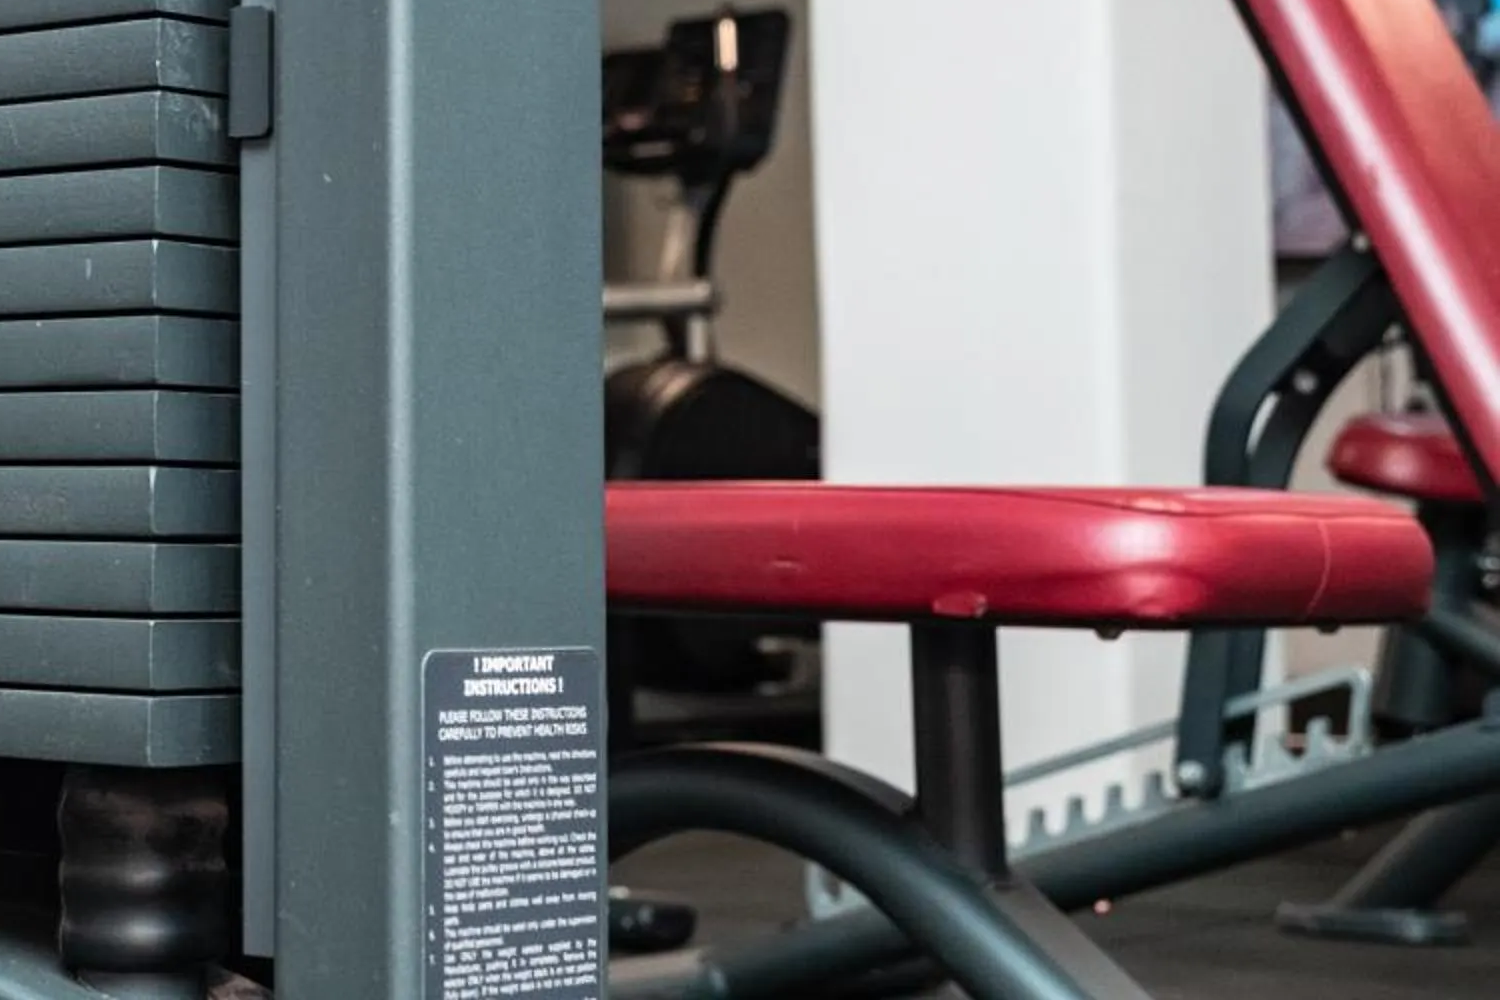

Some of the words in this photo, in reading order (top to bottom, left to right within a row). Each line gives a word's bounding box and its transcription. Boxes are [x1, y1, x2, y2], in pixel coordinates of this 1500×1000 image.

[481, 656, 555, 673] IMPORTANT
[464, 678, 556, 697] INSTRUCTIONS
[505, 707, 529, 721] THESE
[484, 725, 497, 740] TO
